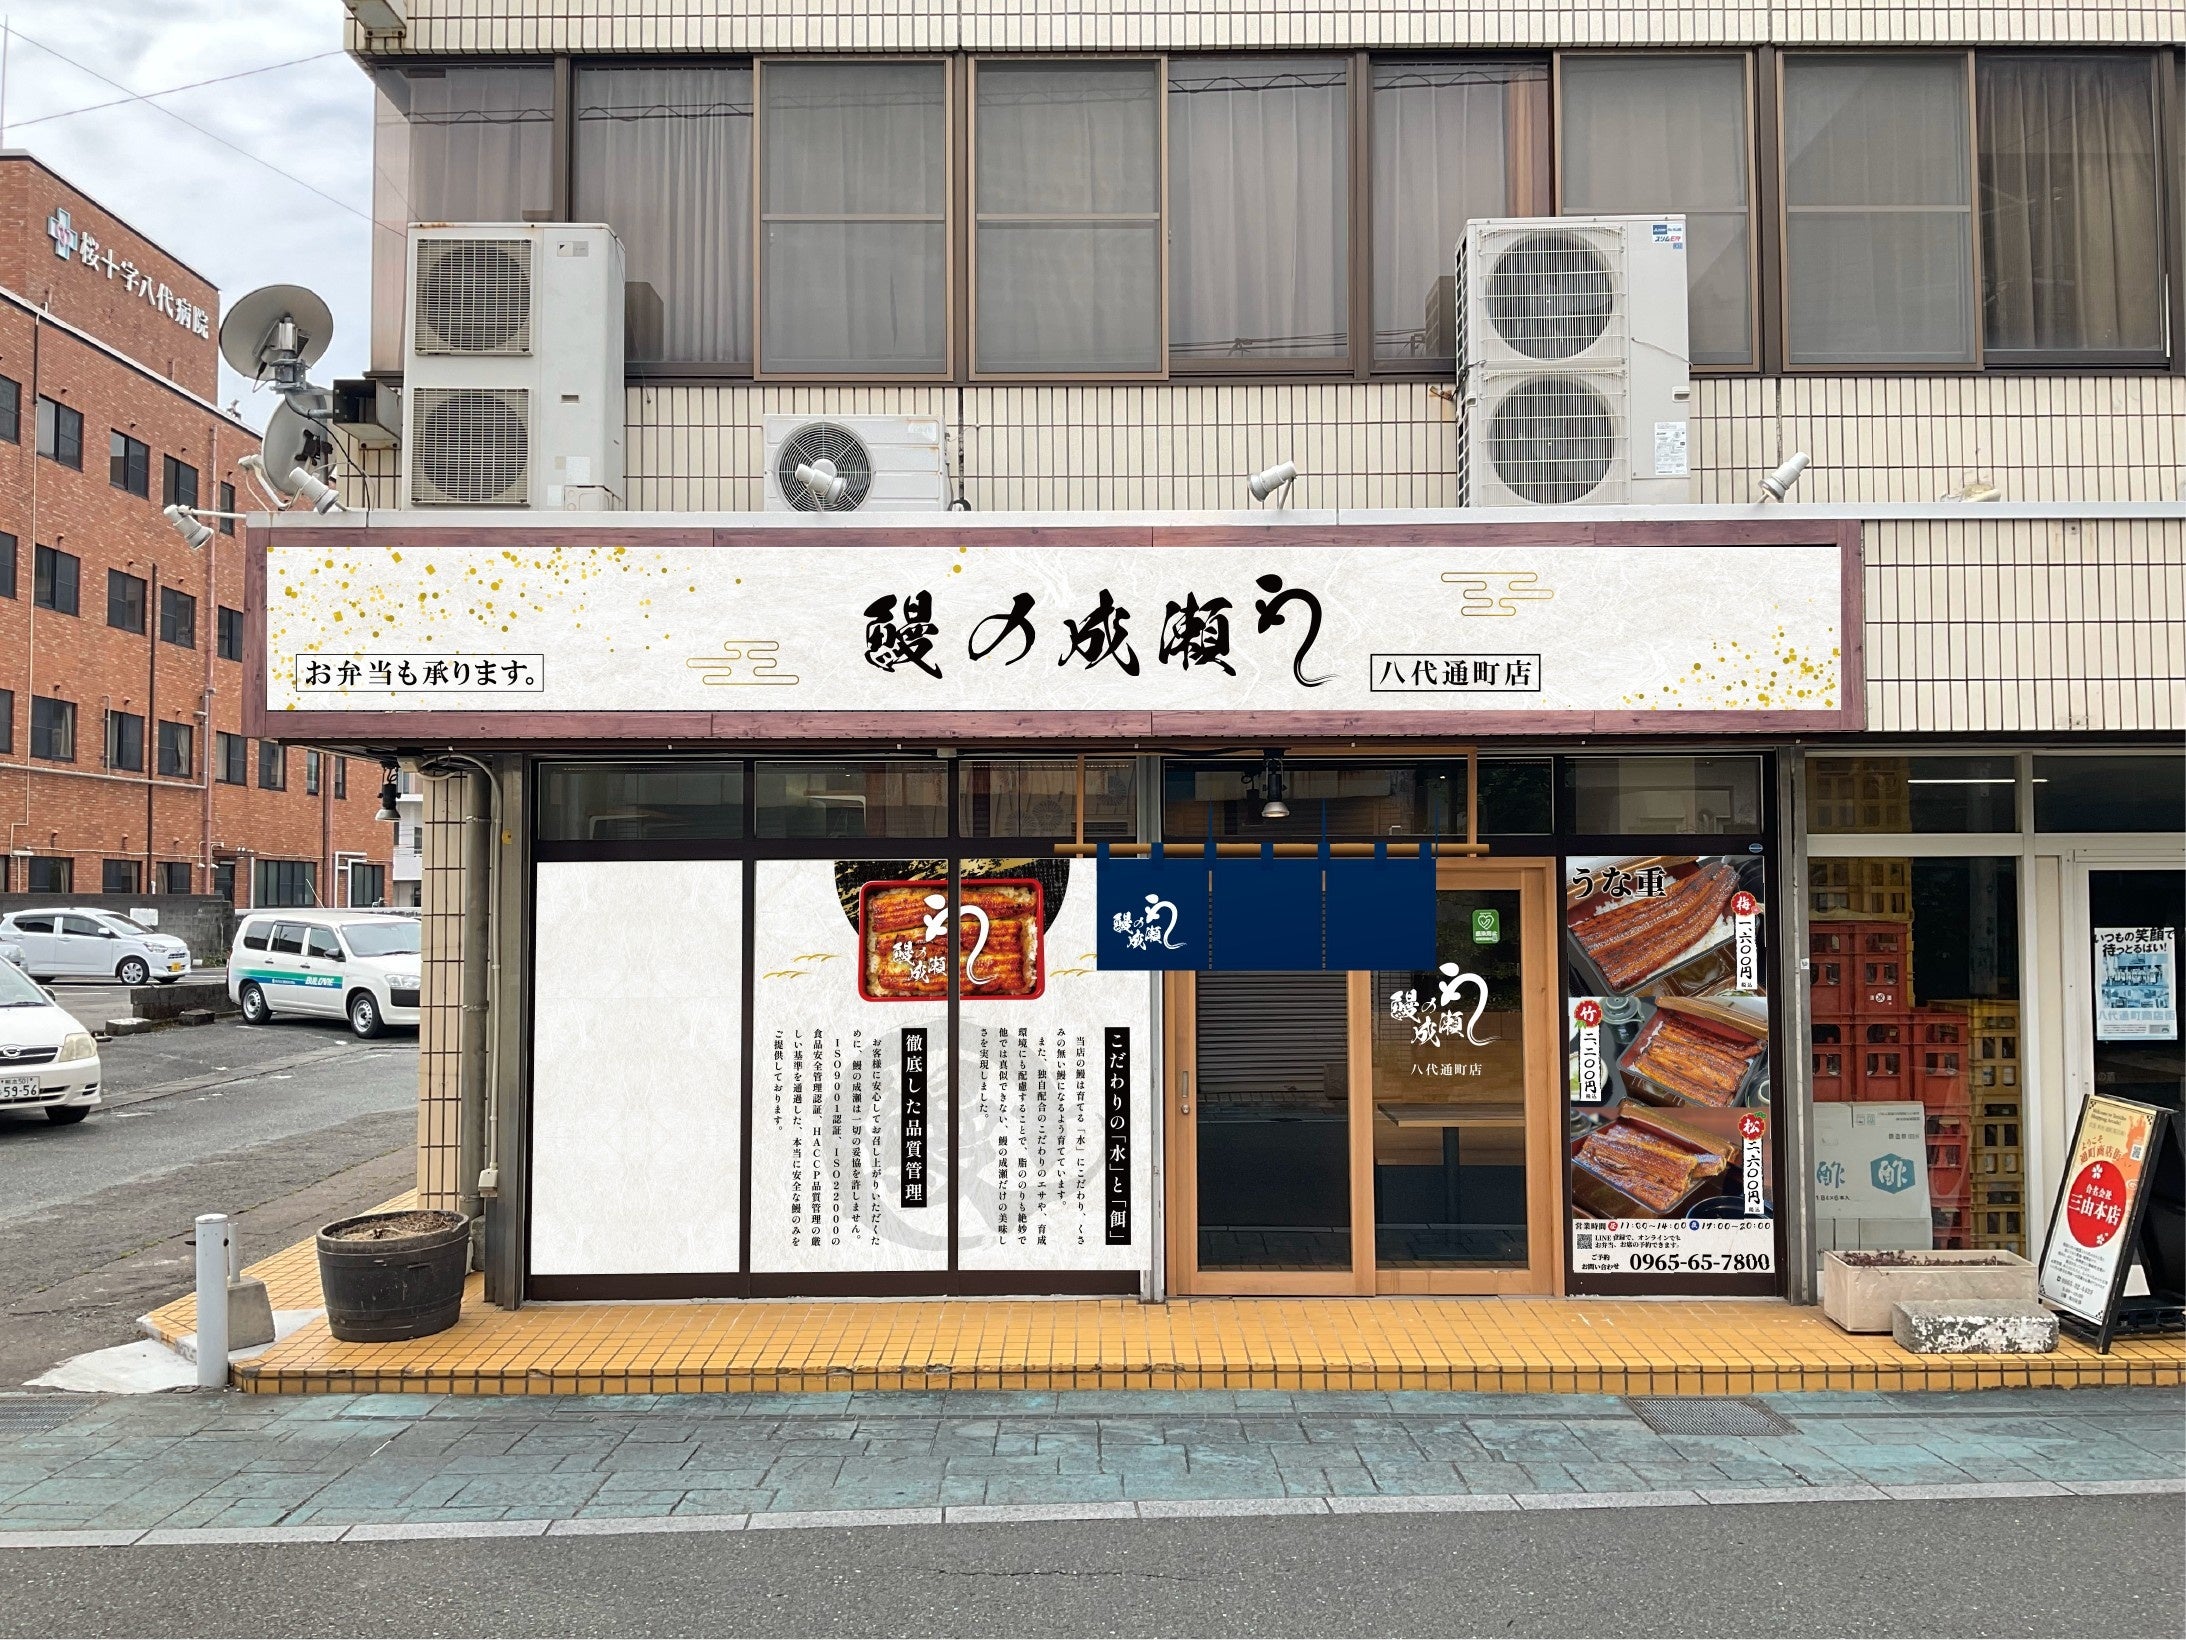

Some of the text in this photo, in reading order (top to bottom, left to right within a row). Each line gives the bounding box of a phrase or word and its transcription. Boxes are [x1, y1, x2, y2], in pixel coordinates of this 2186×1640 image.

[79, 231, 209, 340] 桜十字八代病院
[864, 588, 1238, 680] 鰻の成瀬
[305, 659, 537, 686] お弁当も承ります。
[1379, 659, 1532, 687] 八代通町店
[1572, 866, 1667, 898] うな重
[1736, 896, 1751, 910] 梅
[2095, 927, 2176, 943] いつもの笑顔で
[1580, 1006, 1597, 1022] 竹
[773, 1029, 784, 1131] ご提供しております。
[979, 1028, 989, 1120] さを実現しました。
[1410, 1063, 1483, 1076] 八代通町店
[4, 1084, 37, 1097] 59-56
[905, 1034, 923, 1201] 徹底した品質管理
[1056, 1028, 1067, 1207] みの無い鰻になるよう育てています。
[1743, 1118, 1760, 1135] 松
[791, 1029, 803, 1246] しい基準を通過した、本当に安全な鰻のみを
[851, 1029, 862, 1241] めに、鰻の成瀬は一切の妥協を許しません。
[871, 1038, 882, 1246] お客様に安心してお召し上がりいただくた
[998, 1027, 1009, 1245] 他では真似できない、鰻の成瀬だけの美味し
[1017, 1027, 1028, 1245] 環境にも配慮することで、脂ののりも絶妙で
[1036, 1037, 1047, 1245] また、独自配合のこだわりのエサや、育成
[1109, 1033, 1127, 1238] こだわりの「水」と「餌」
[2081, 1134, 2103, 1151] ようこそ
[2085, 1183, 2113, 1201] 合名会社
[1575, 1222, 1606, 1230] 営業時間
[2068, 1193, 2122, 1226] 三由本店
[1629, 1253, 1770, 1271] 0965-65-7800
